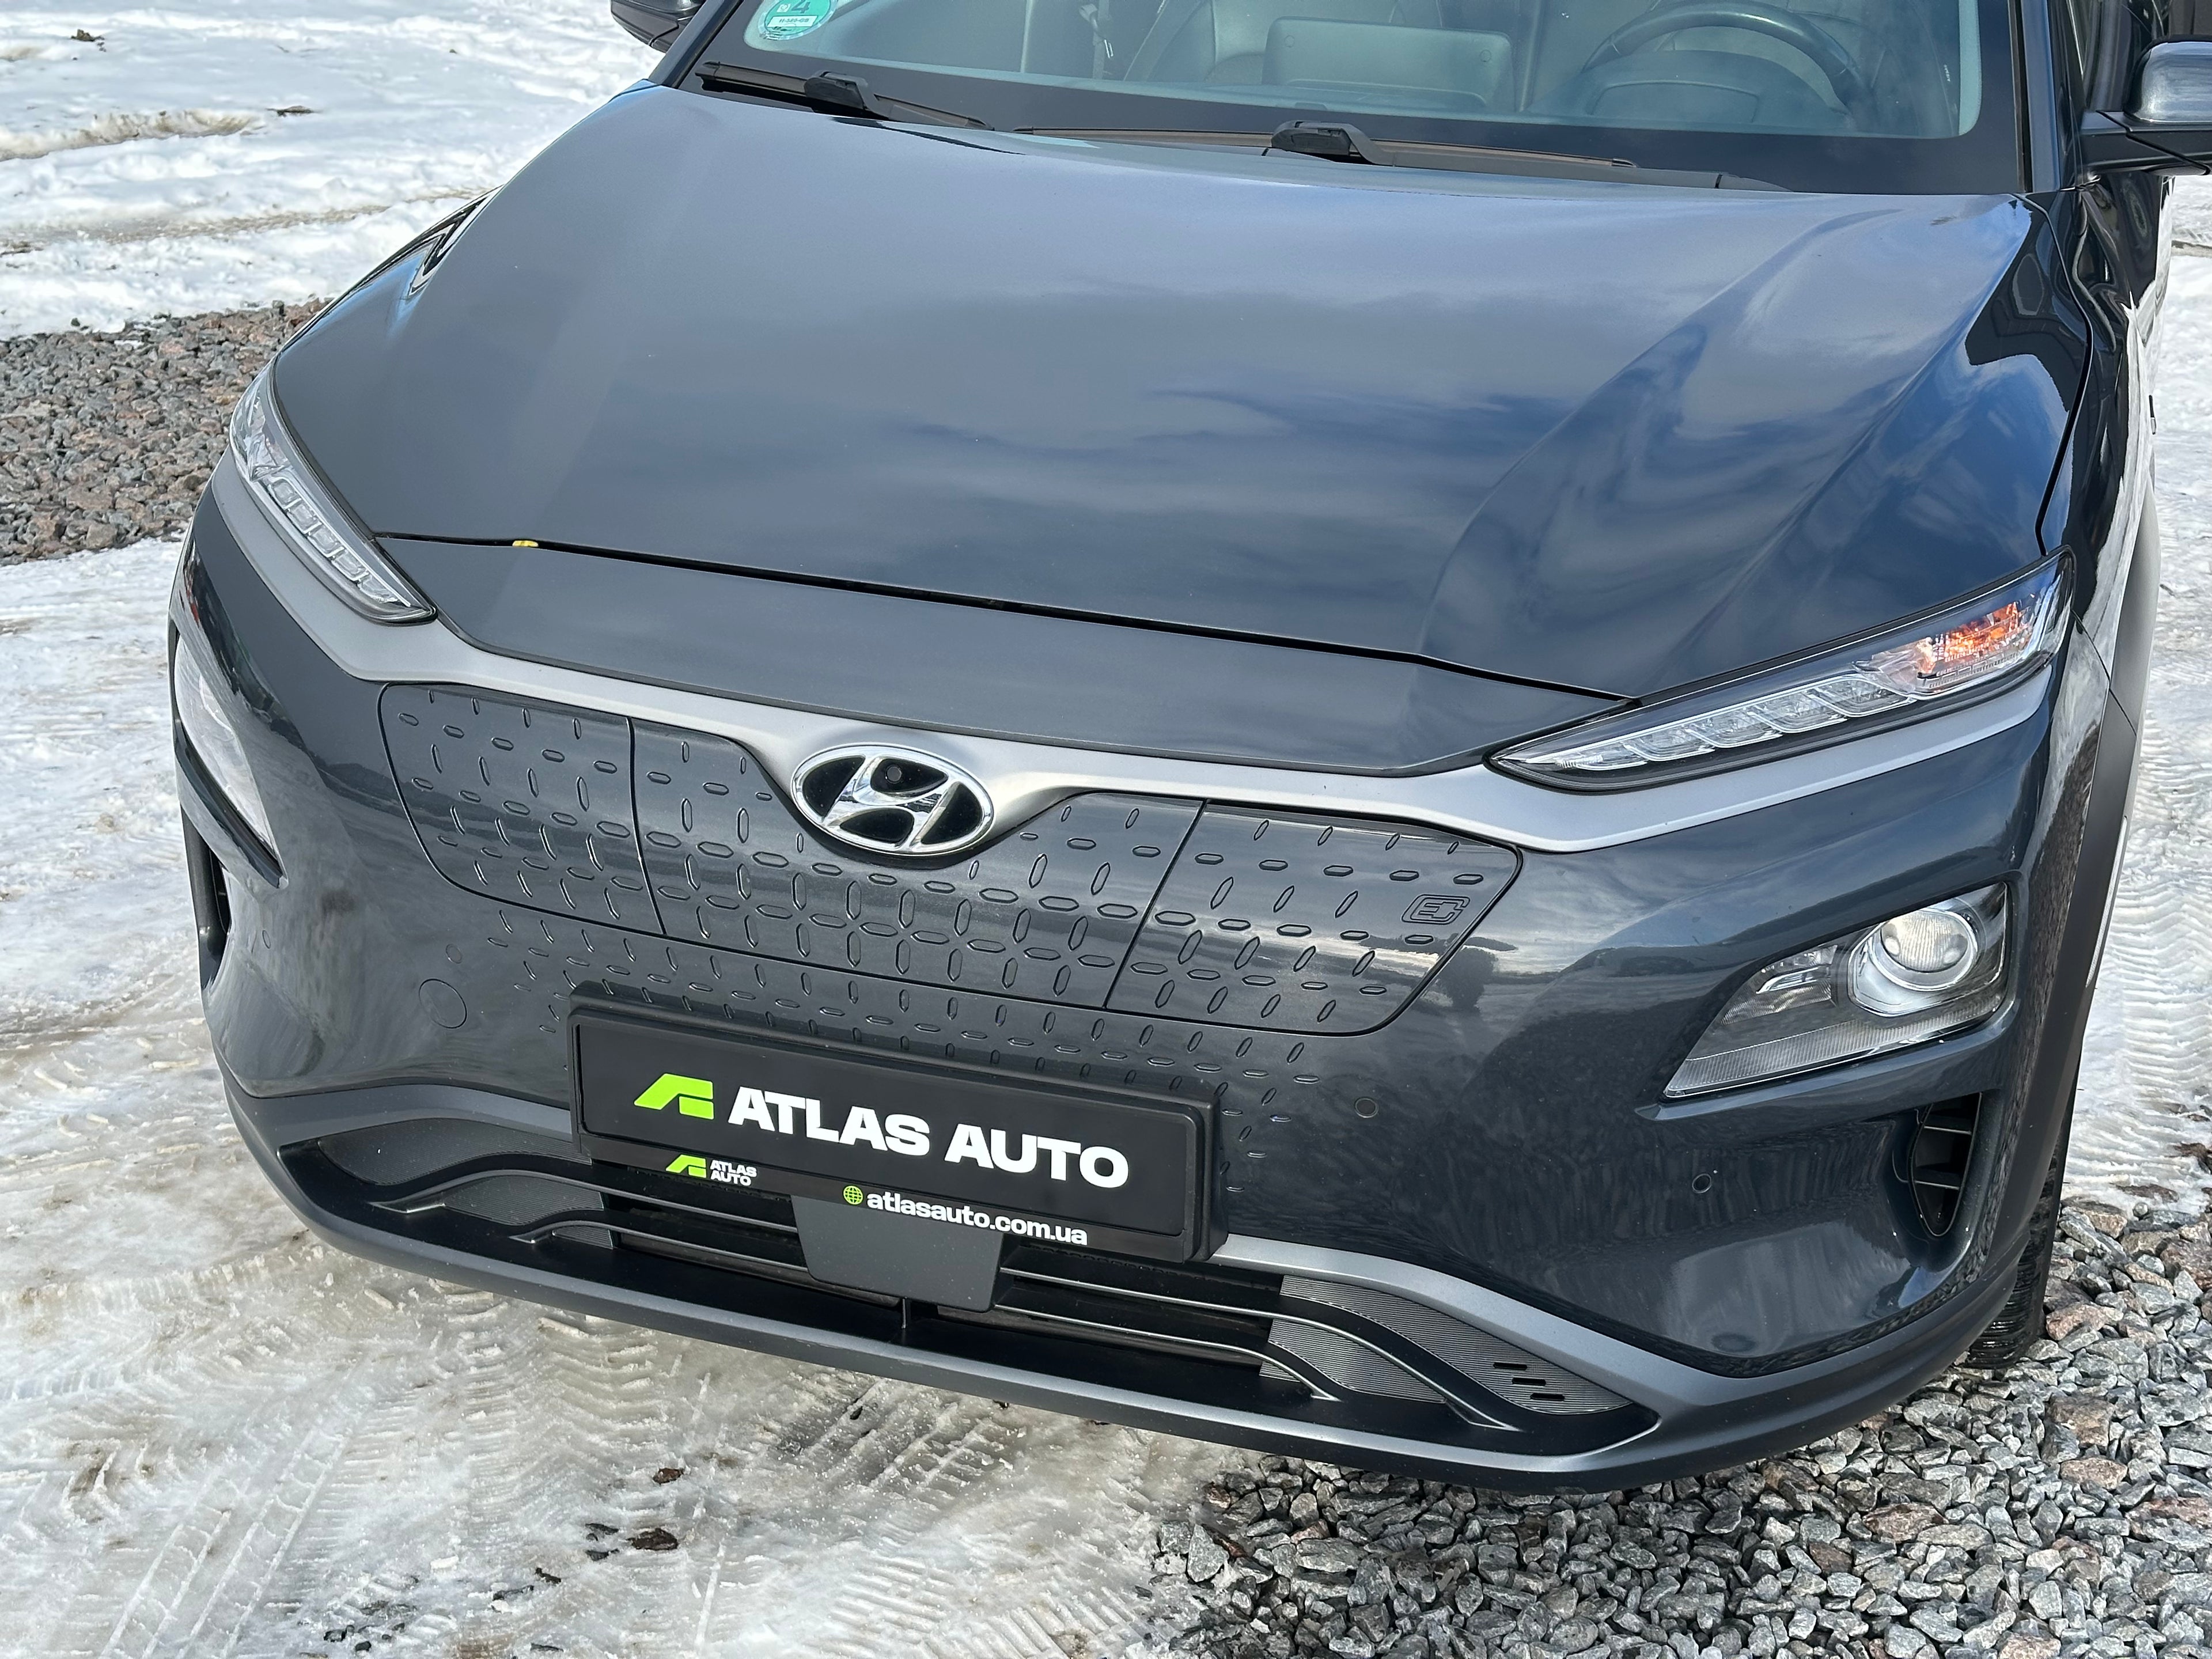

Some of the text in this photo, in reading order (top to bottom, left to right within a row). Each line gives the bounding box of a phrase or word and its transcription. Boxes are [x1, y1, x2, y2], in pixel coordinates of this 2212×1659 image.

[791, 0, 811, 14] 4
[728, 1086, 1130, 1189] ATLAS AUTO
[710, 1160, 757, 1177] ATLAS
[710, 1170, 751, 1186] AUTO
[867, 1191, 1088, 1246] atlasauto.com.ua
